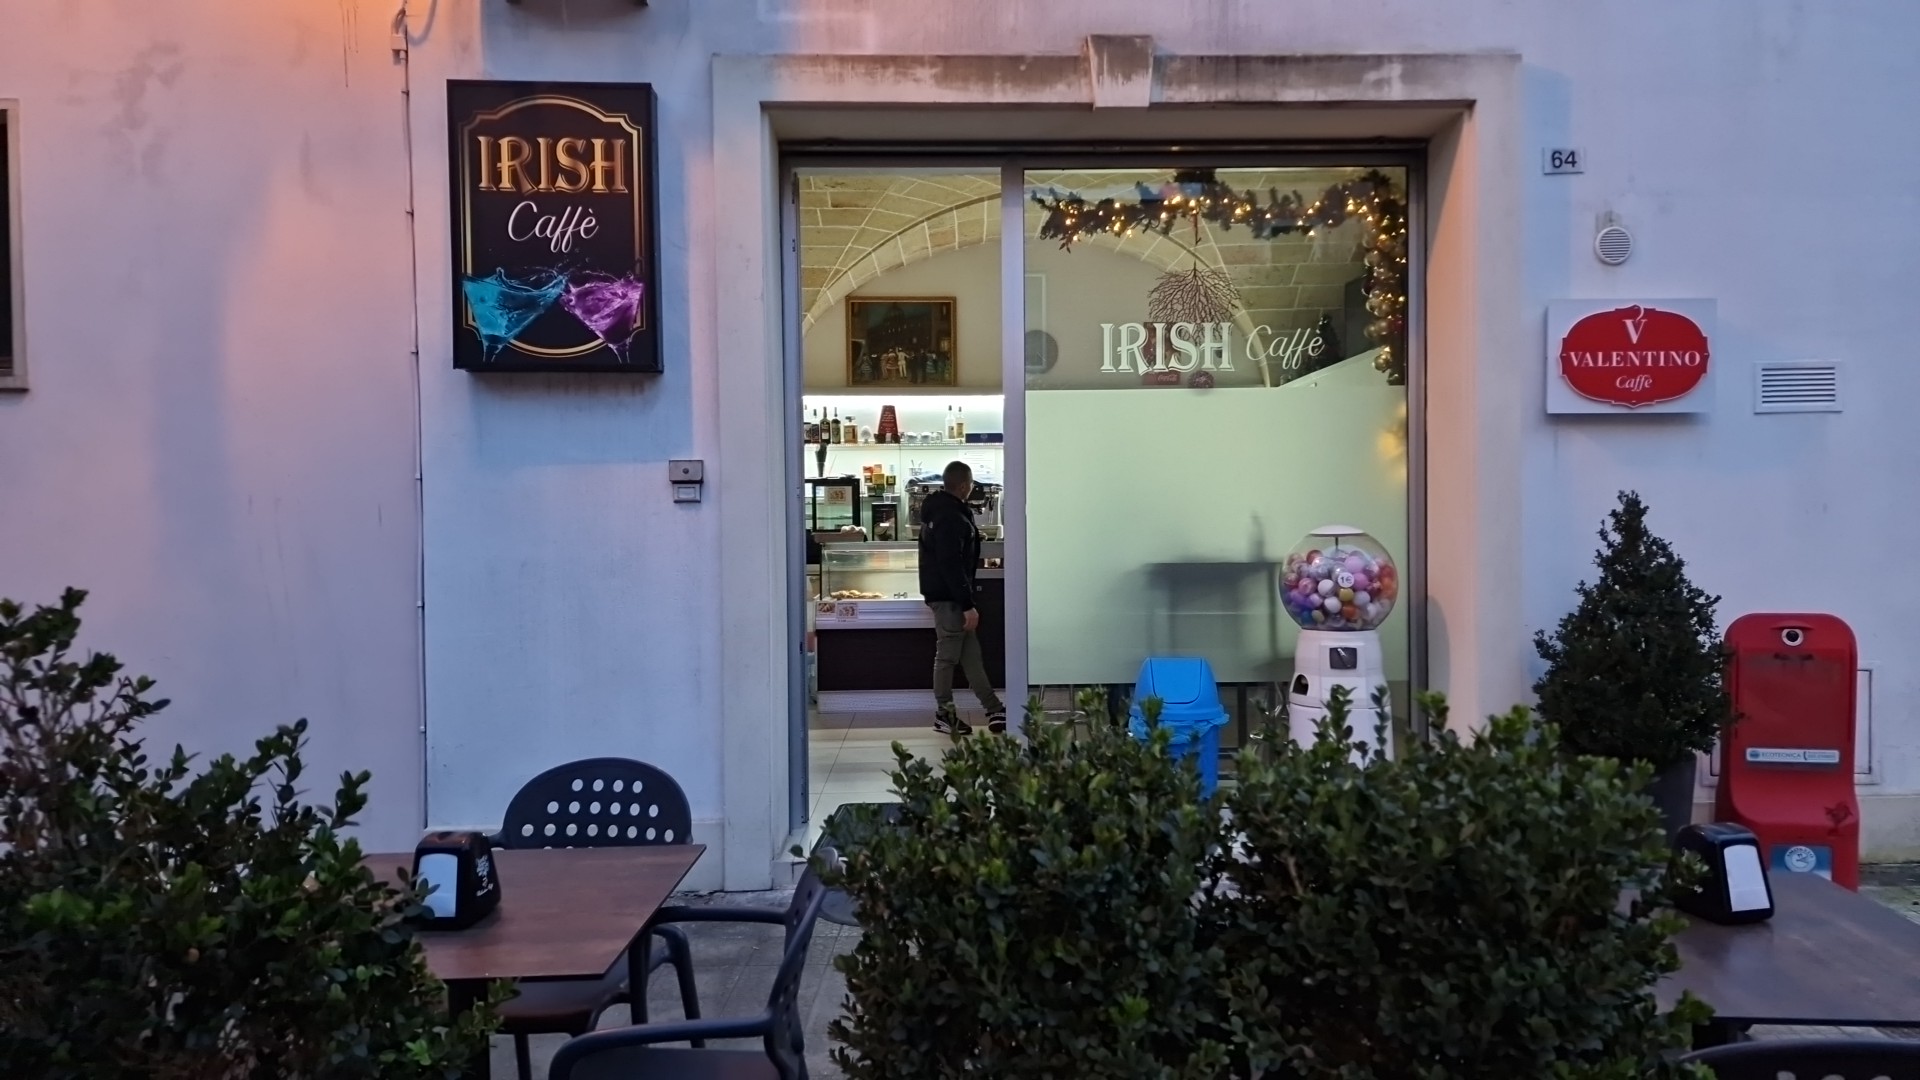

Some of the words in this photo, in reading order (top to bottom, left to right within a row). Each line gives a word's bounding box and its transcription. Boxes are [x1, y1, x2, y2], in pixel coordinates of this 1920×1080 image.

[477, 135, 628, 195] IRISH
[1551, 151, 1577, 169] 64
[507, 201, 600, 253] Caffè
[1100, 322, 1235, 376] IRISH
[1245, 324, 1326, 370] Caffè
[1569, 350, 1701, 368] VALENTINO
[1615, 374, 1653, 392] Caffè
